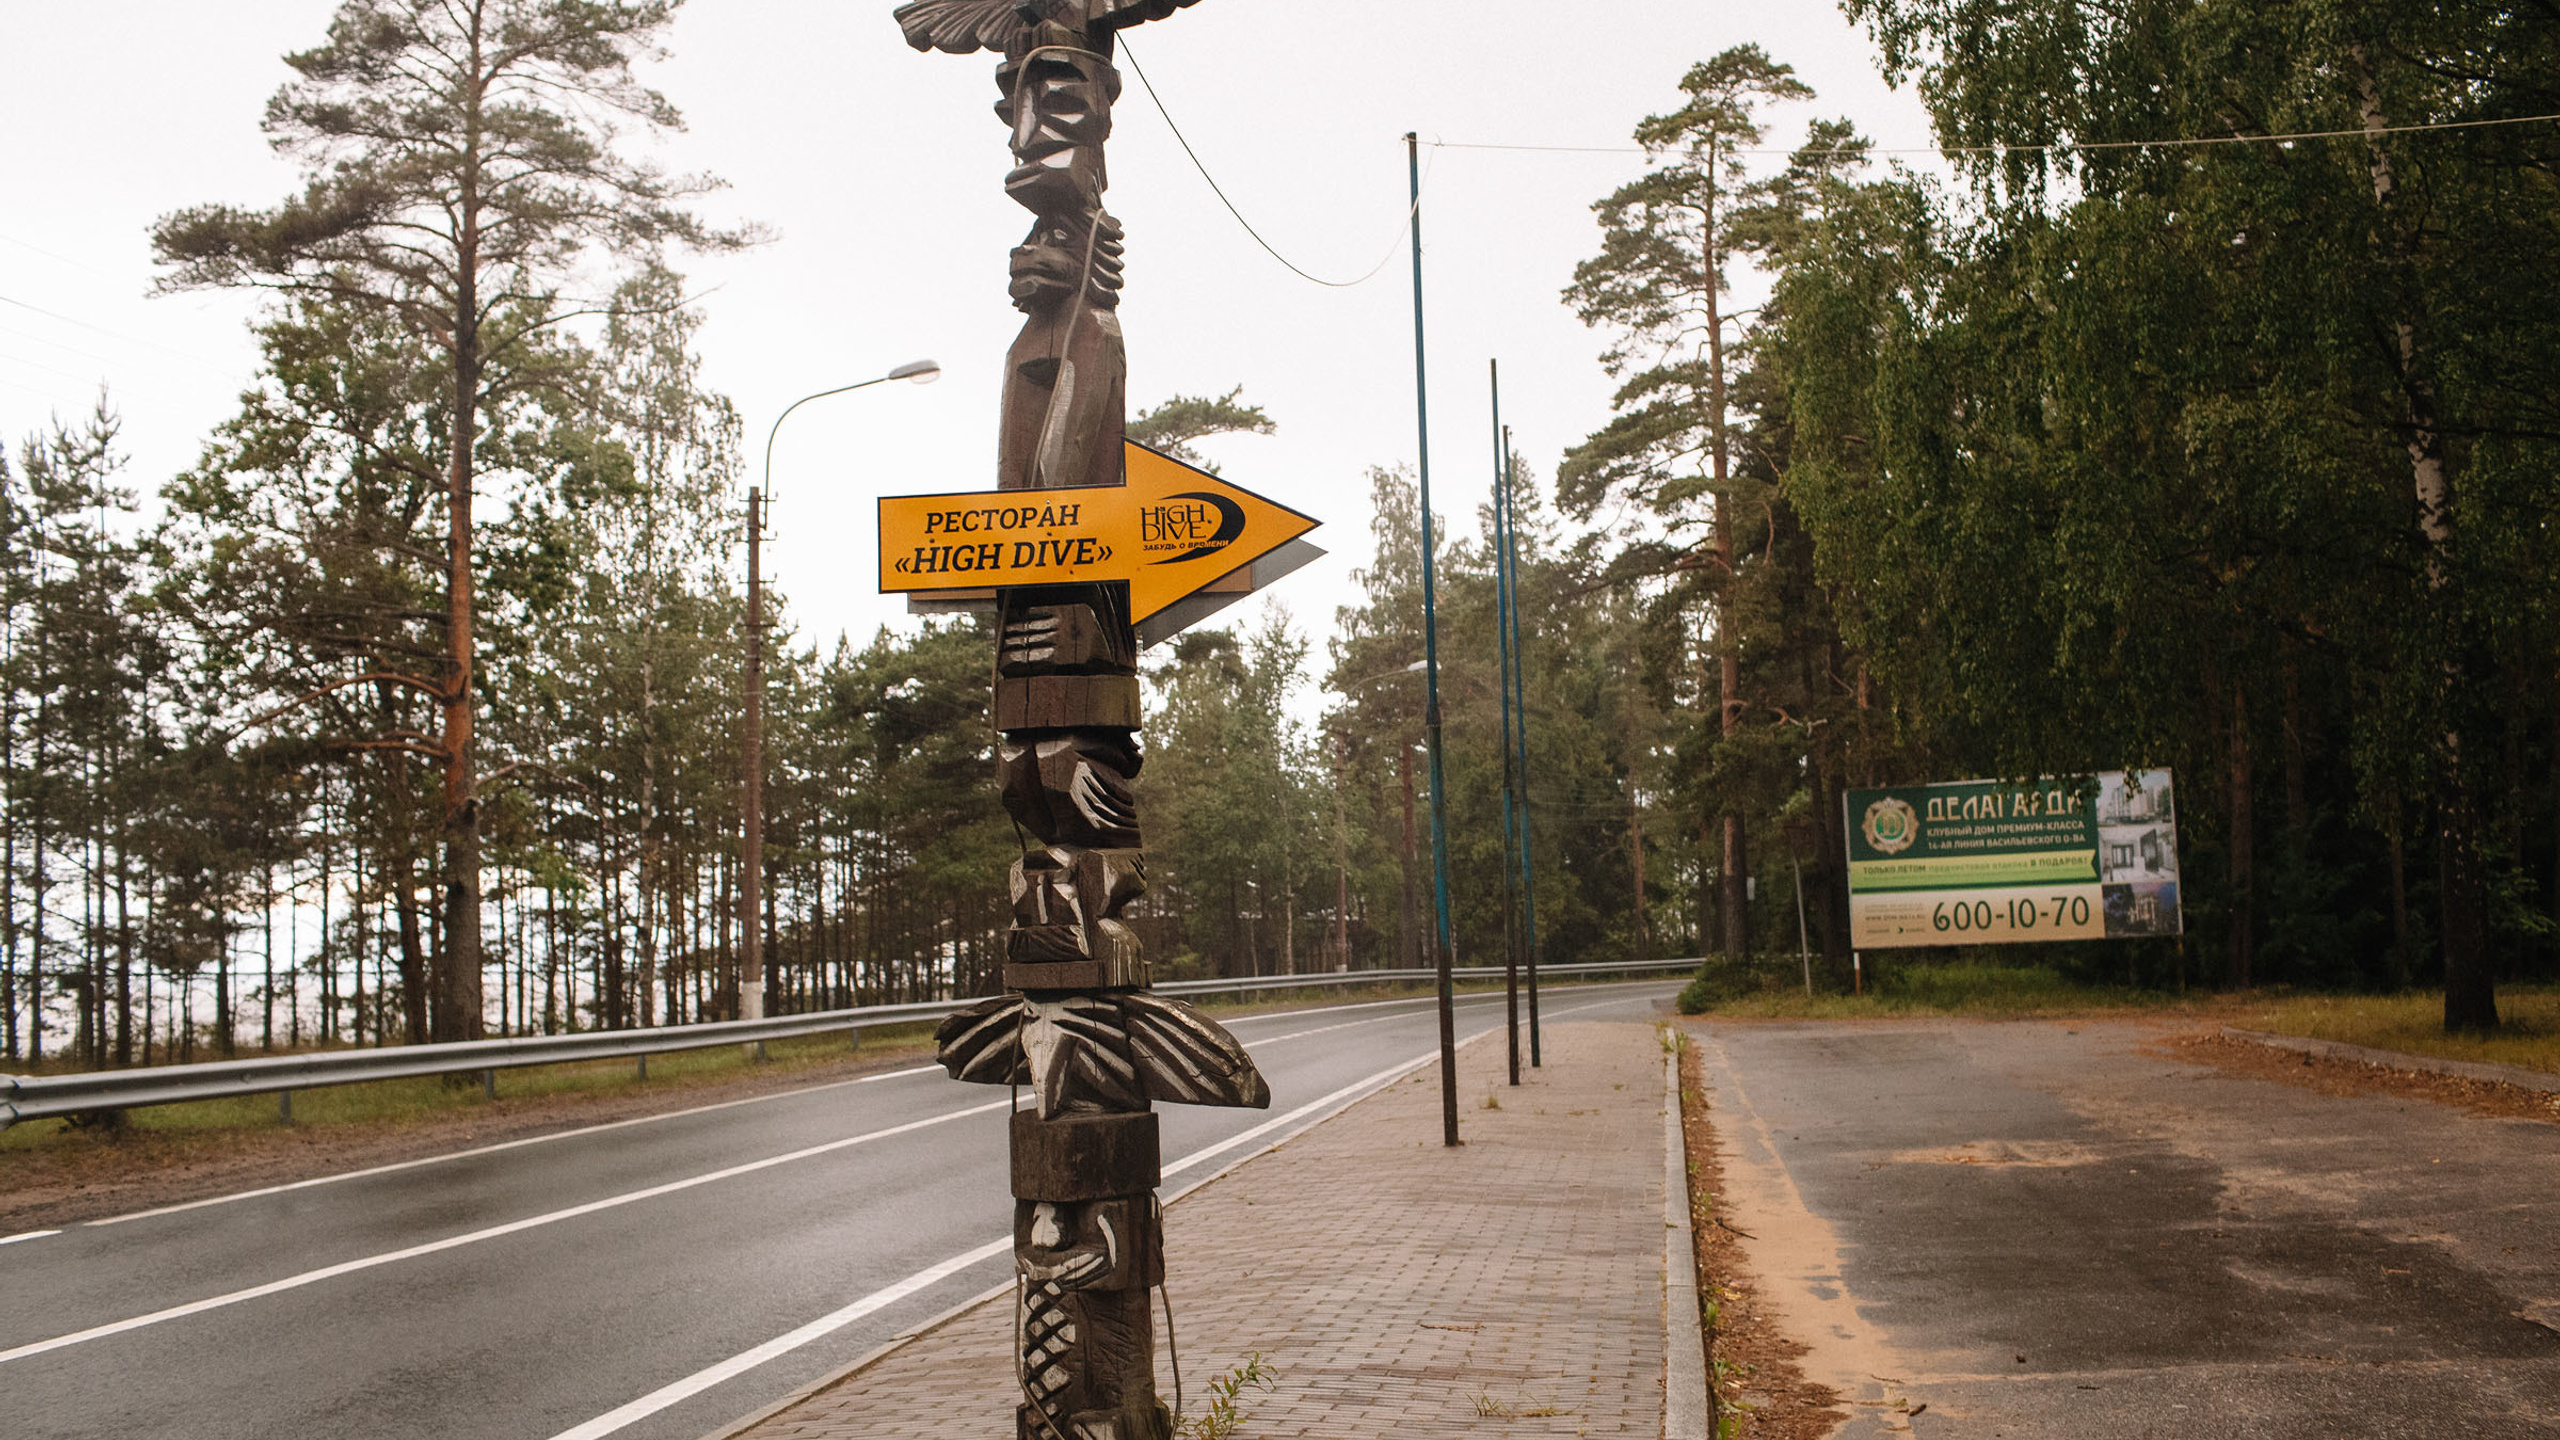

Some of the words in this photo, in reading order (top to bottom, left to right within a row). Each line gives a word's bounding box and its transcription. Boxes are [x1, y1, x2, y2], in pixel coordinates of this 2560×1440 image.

[924, 504, 1081, 534] РЕСТОРАН
[894, 543, 1004, 574] «HIGH
[1011, 537, 1113, 569] DIVE»
[1143, 543, 1177, 551] ЗАБУДЬ
[1926, 825, 1972, 837] КЛУБНЫЙ
[1974, 825, 1995, 836] ДОМ
[1997, 820, 2085, 833] ПРЕМИУМ-КЛАССА
[1928, 840, 1953, 850] 14-АЯ
[1954, 838, 1985, 849] ЛИНИЯ
[1986, 834, 2062, 848] ВАСИЛЬЕВСКОГО
[2063, 832, 2086, 844] О-ВА
[1864, 866, 1896, 874] ТОЛЬКО
[1897, 864, 1926, 873] ЛЕТОМ
[2039, 856, 2088, 866] ПОДАРОК!
[1933, 895, 2090, 932] 600-10-70
